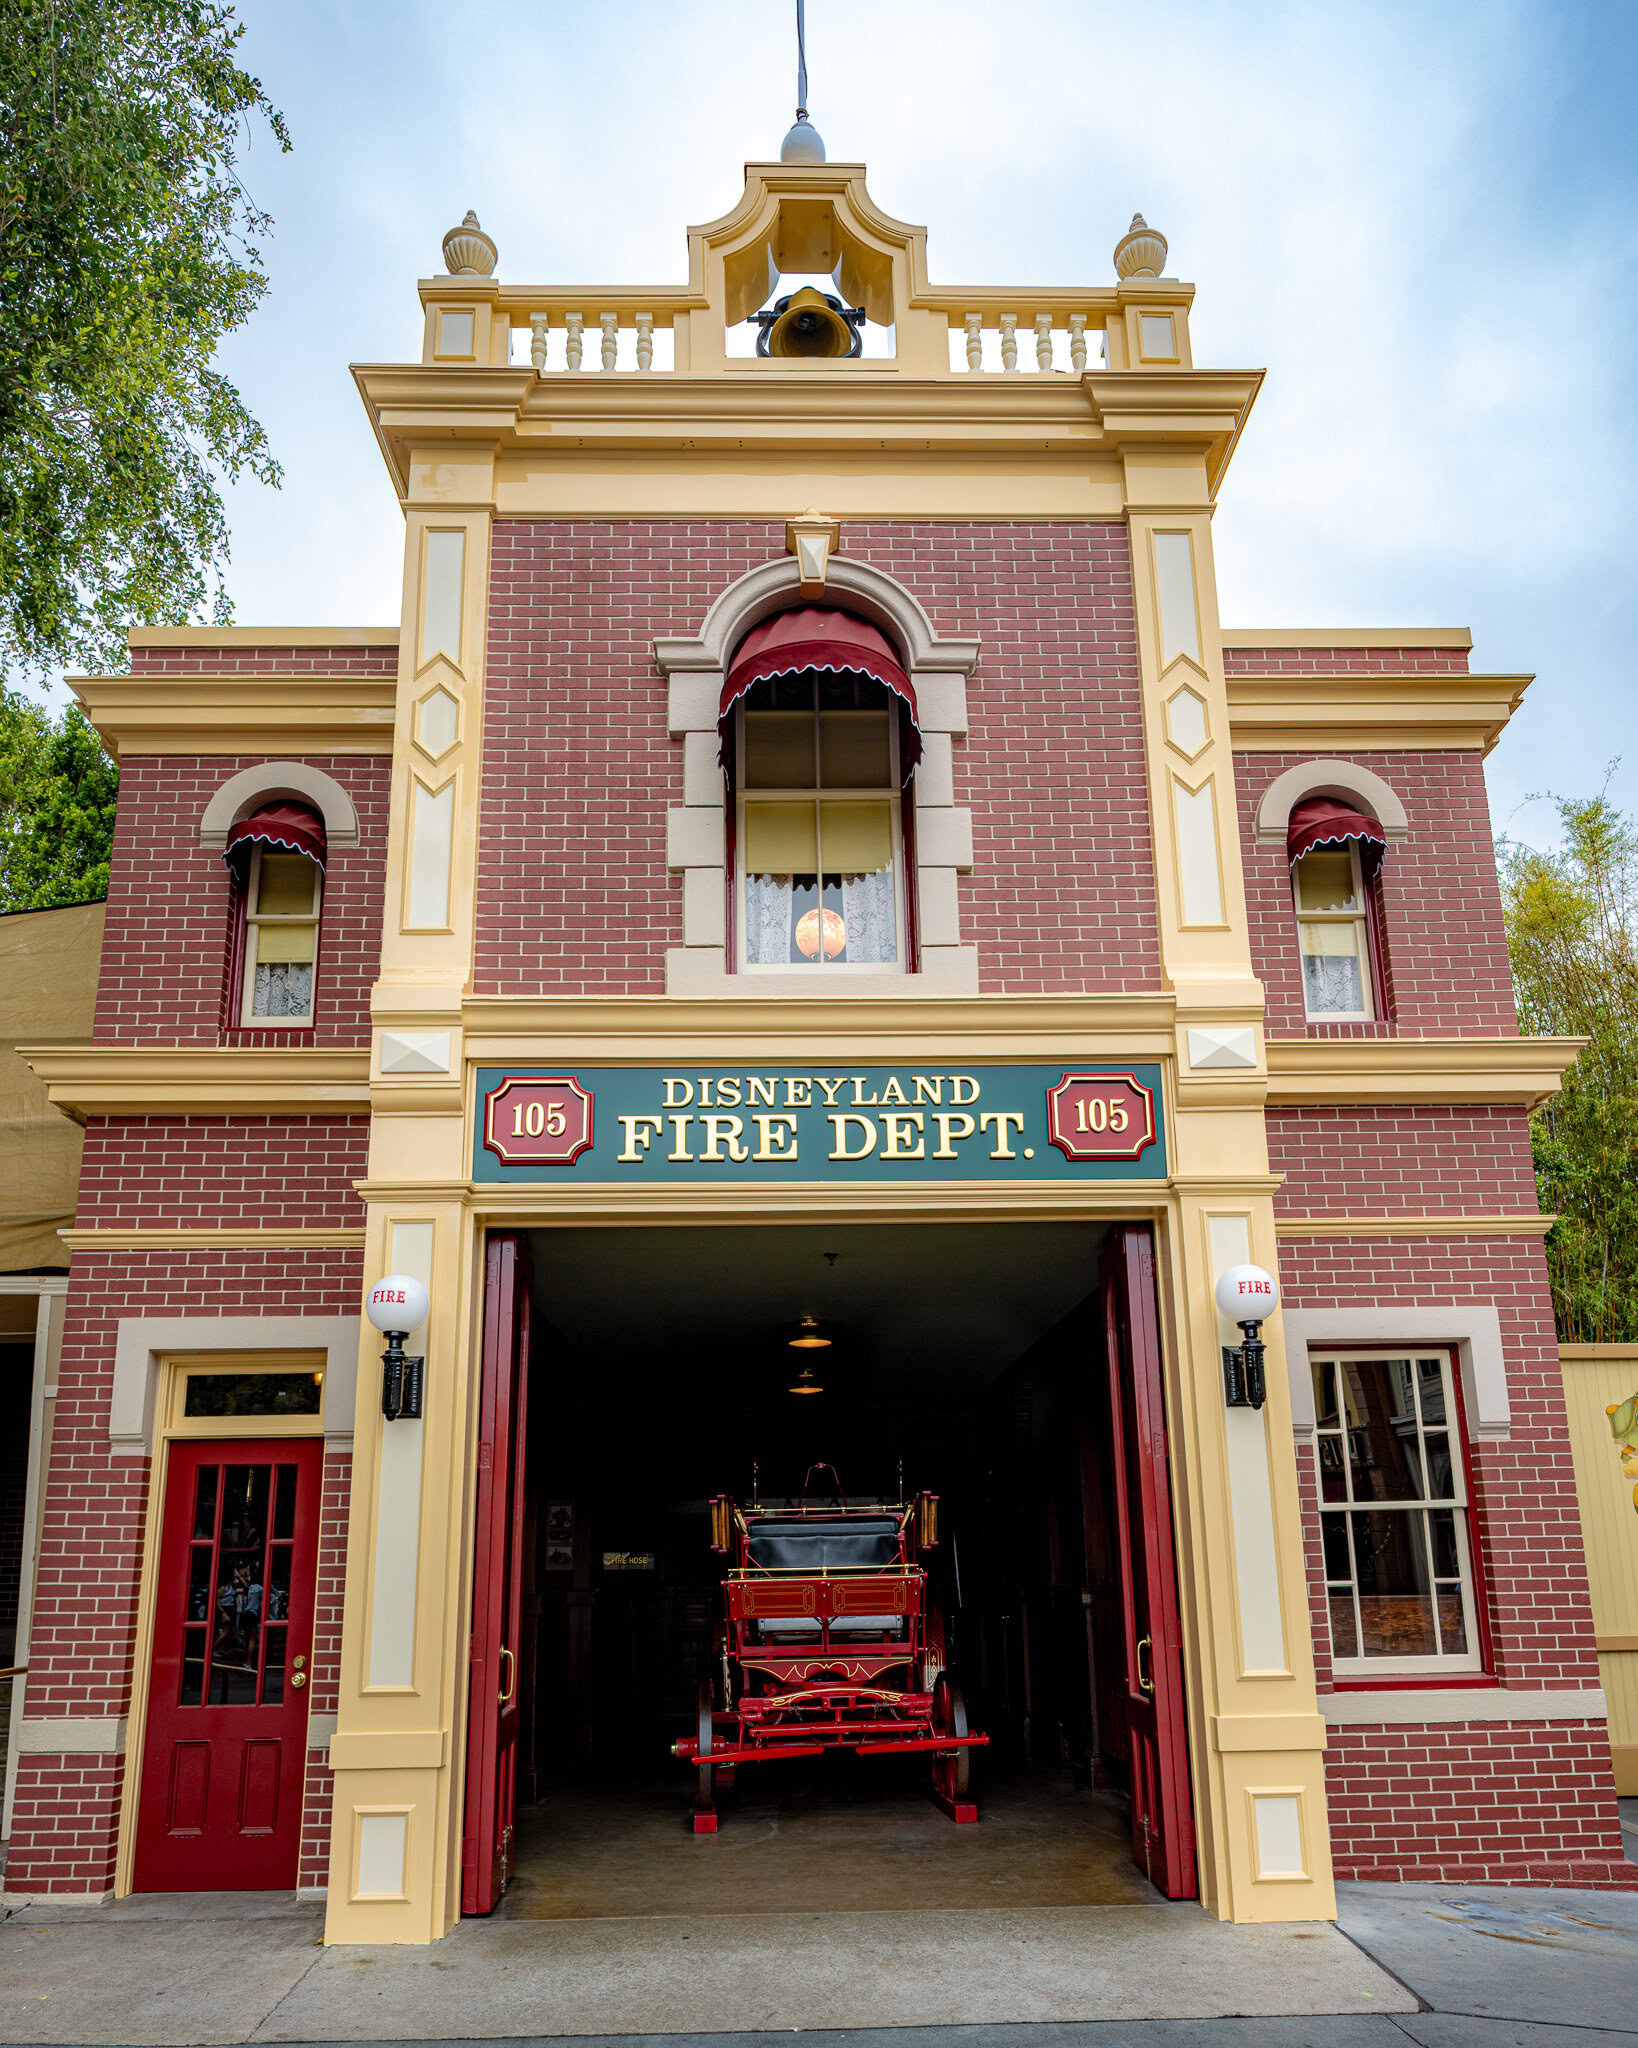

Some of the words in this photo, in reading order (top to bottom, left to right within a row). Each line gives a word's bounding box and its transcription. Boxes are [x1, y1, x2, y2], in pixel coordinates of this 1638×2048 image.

[662, 1075, 981, 1108] DISNEYLAND
[510, 1102, 568, 1137] 105
[1074, 1098, 1130, 1133] 105
[617, 1113, 799, 1162] FIRE
[827, 1112, 1035, 1160] DEPT.
[372, 1289, 405, 1304] FIRE
[1238, 1280, 1271, 1294] FIRE
